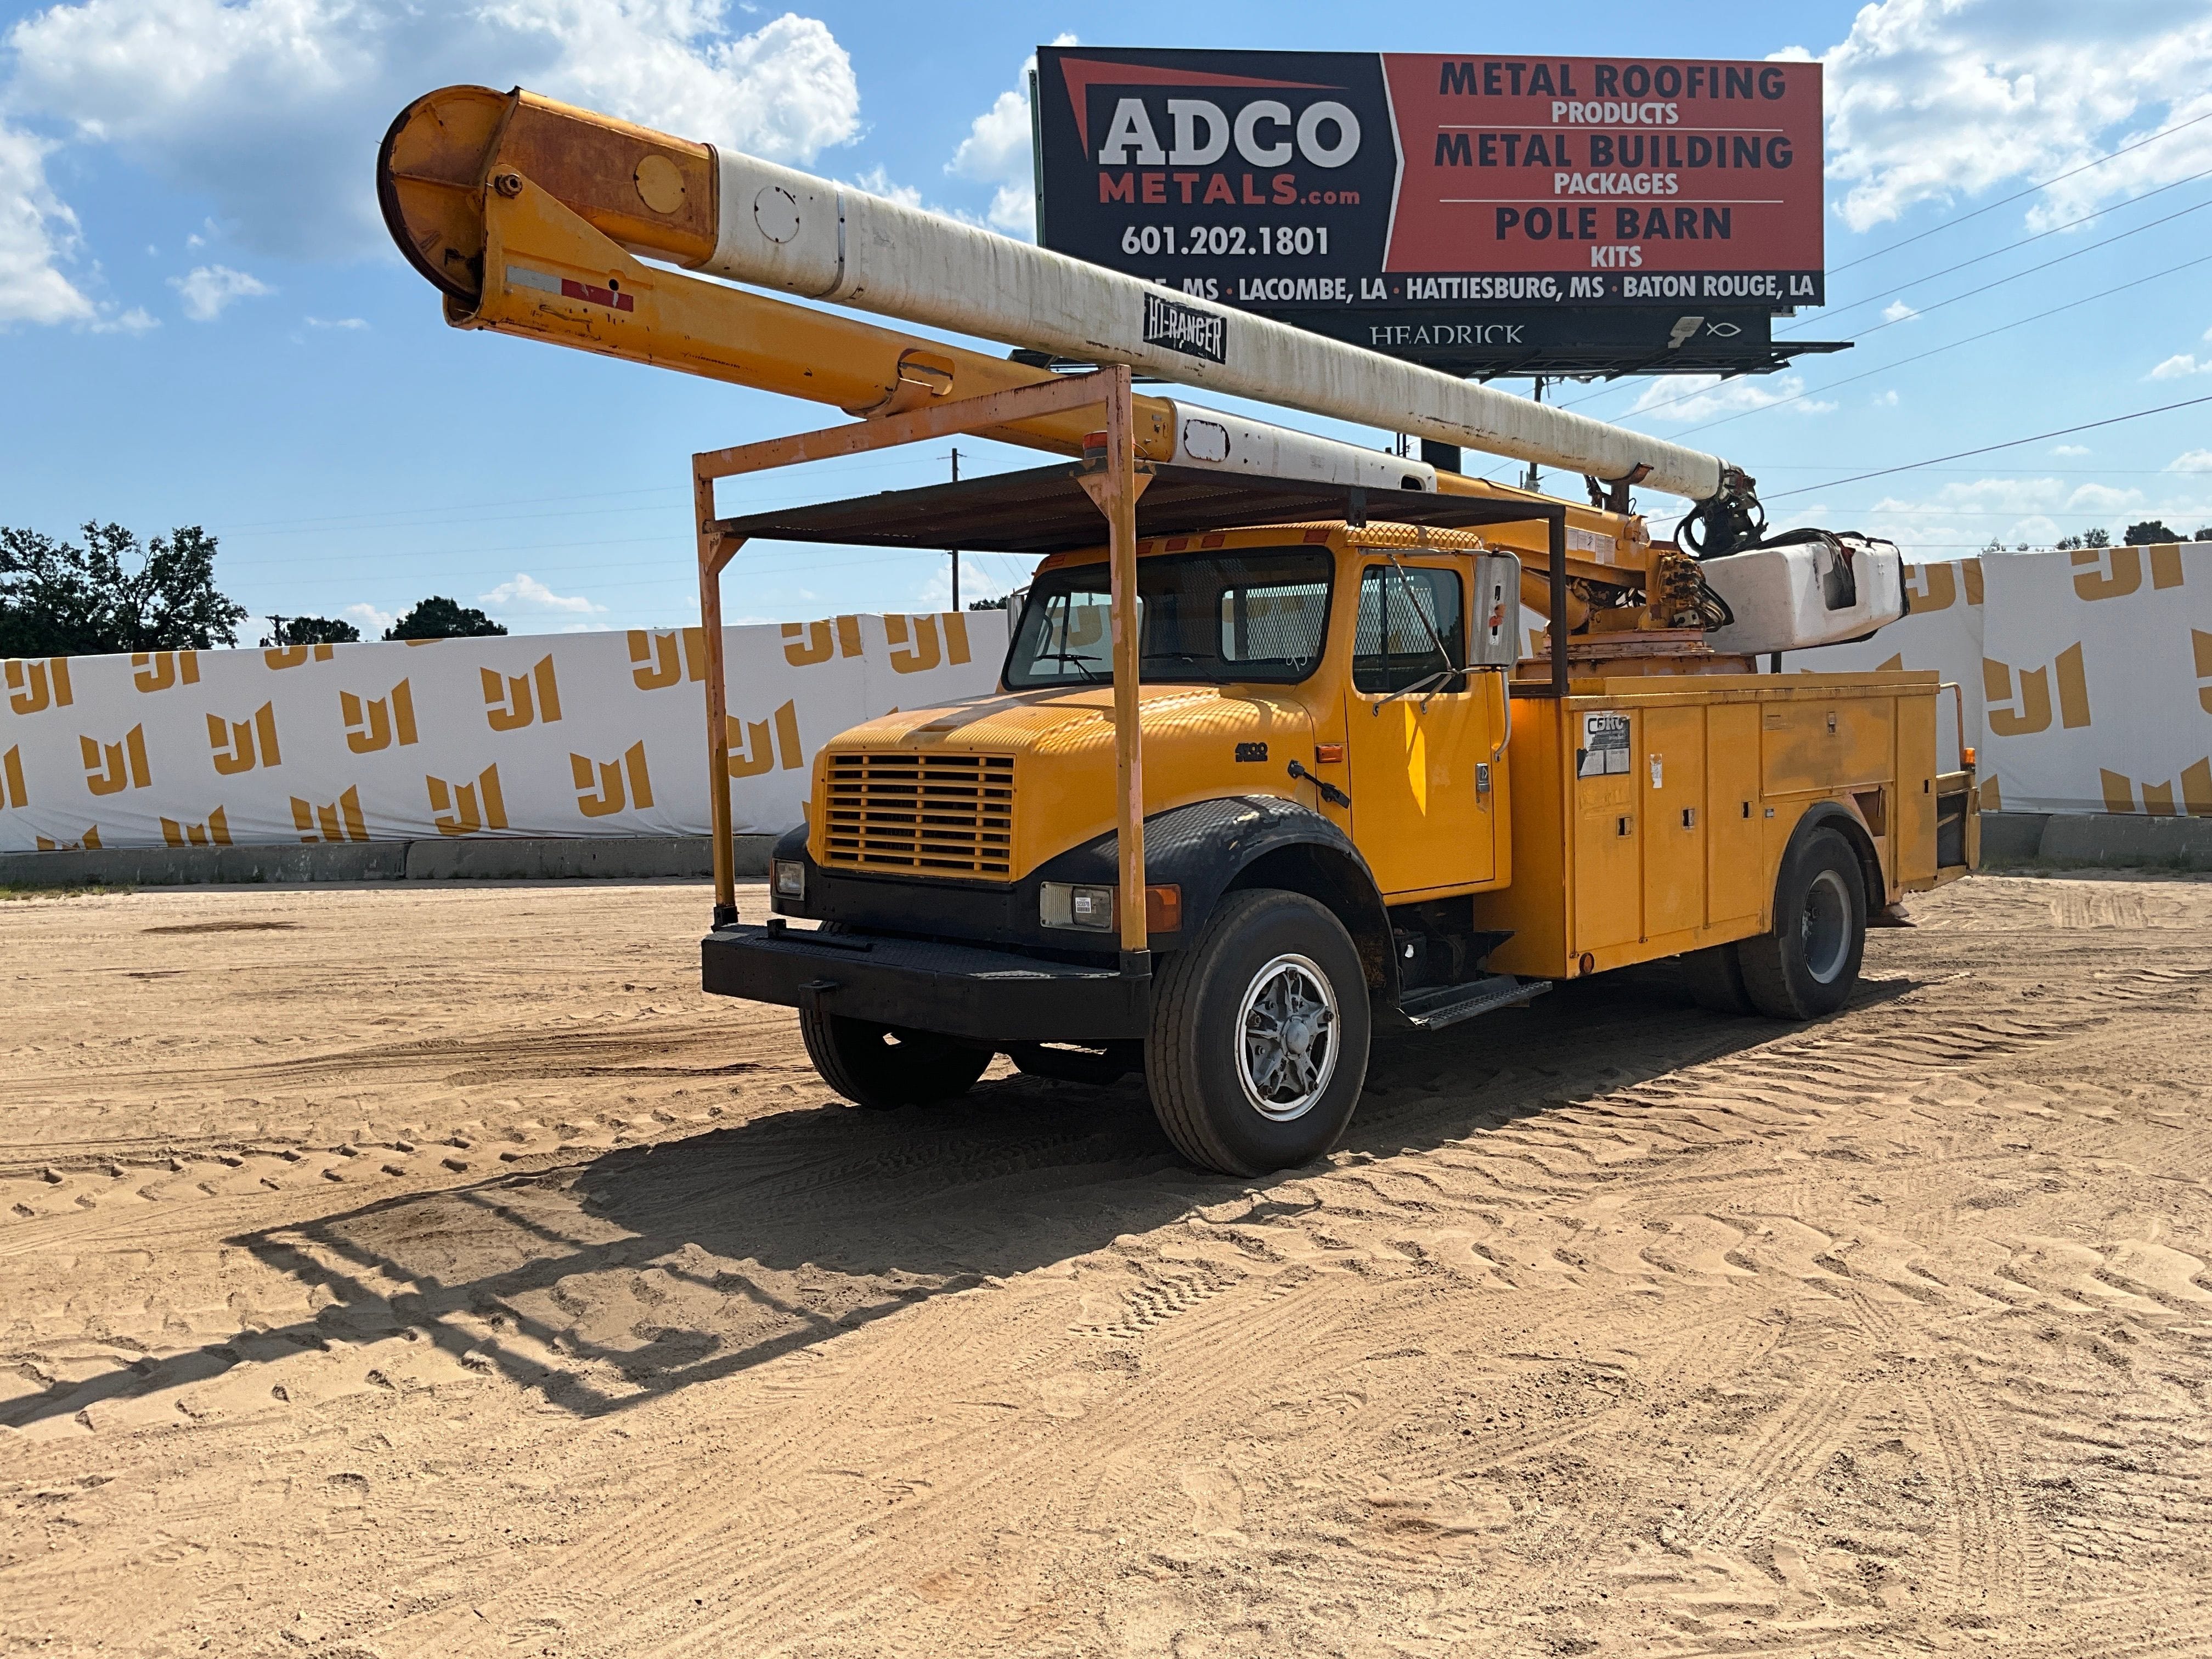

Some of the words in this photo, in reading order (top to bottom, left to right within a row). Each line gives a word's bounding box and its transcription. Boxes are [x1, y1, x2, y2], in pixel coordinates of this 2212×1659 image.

[1439, 61, 1577, 97] METAL
[1594, 64, 1786, 100] ROOFING
[1551, 101, 1679, 125] PRODUCTS
[1098, 98, 1361, 168] ADCO
[1434, 133, 1572, 167] METAL
[1590, 135, 1793, 169] BUILDING
[1554, 172, 1679, 195] PACKAGES
[1496, 206, 1598, 240] POLE
[1616, 207, 1731, 240] BARN
[1122, 226, 1328, 255] 601.202.1801
[1591, 245, 1643, 268] KITS
[1182, 278, 1219, 300] MS
[1239, 278, 1354, 304] LACOMBE,
[1361, 278, 1387, 300] LA
[1407, 276, 1563, 302] HATTIESBURG,
[1570, 276, 1604, 298] MS
[1623, 275, 1696, 297] BATON
[1703, 275, 1783, 300] ROUGE,
[1790, 275, 1815, 296] LA
[1148, 296, 1222, 360] HI-RANGER
[1369, 325, 1525, 345] HEADRICK
